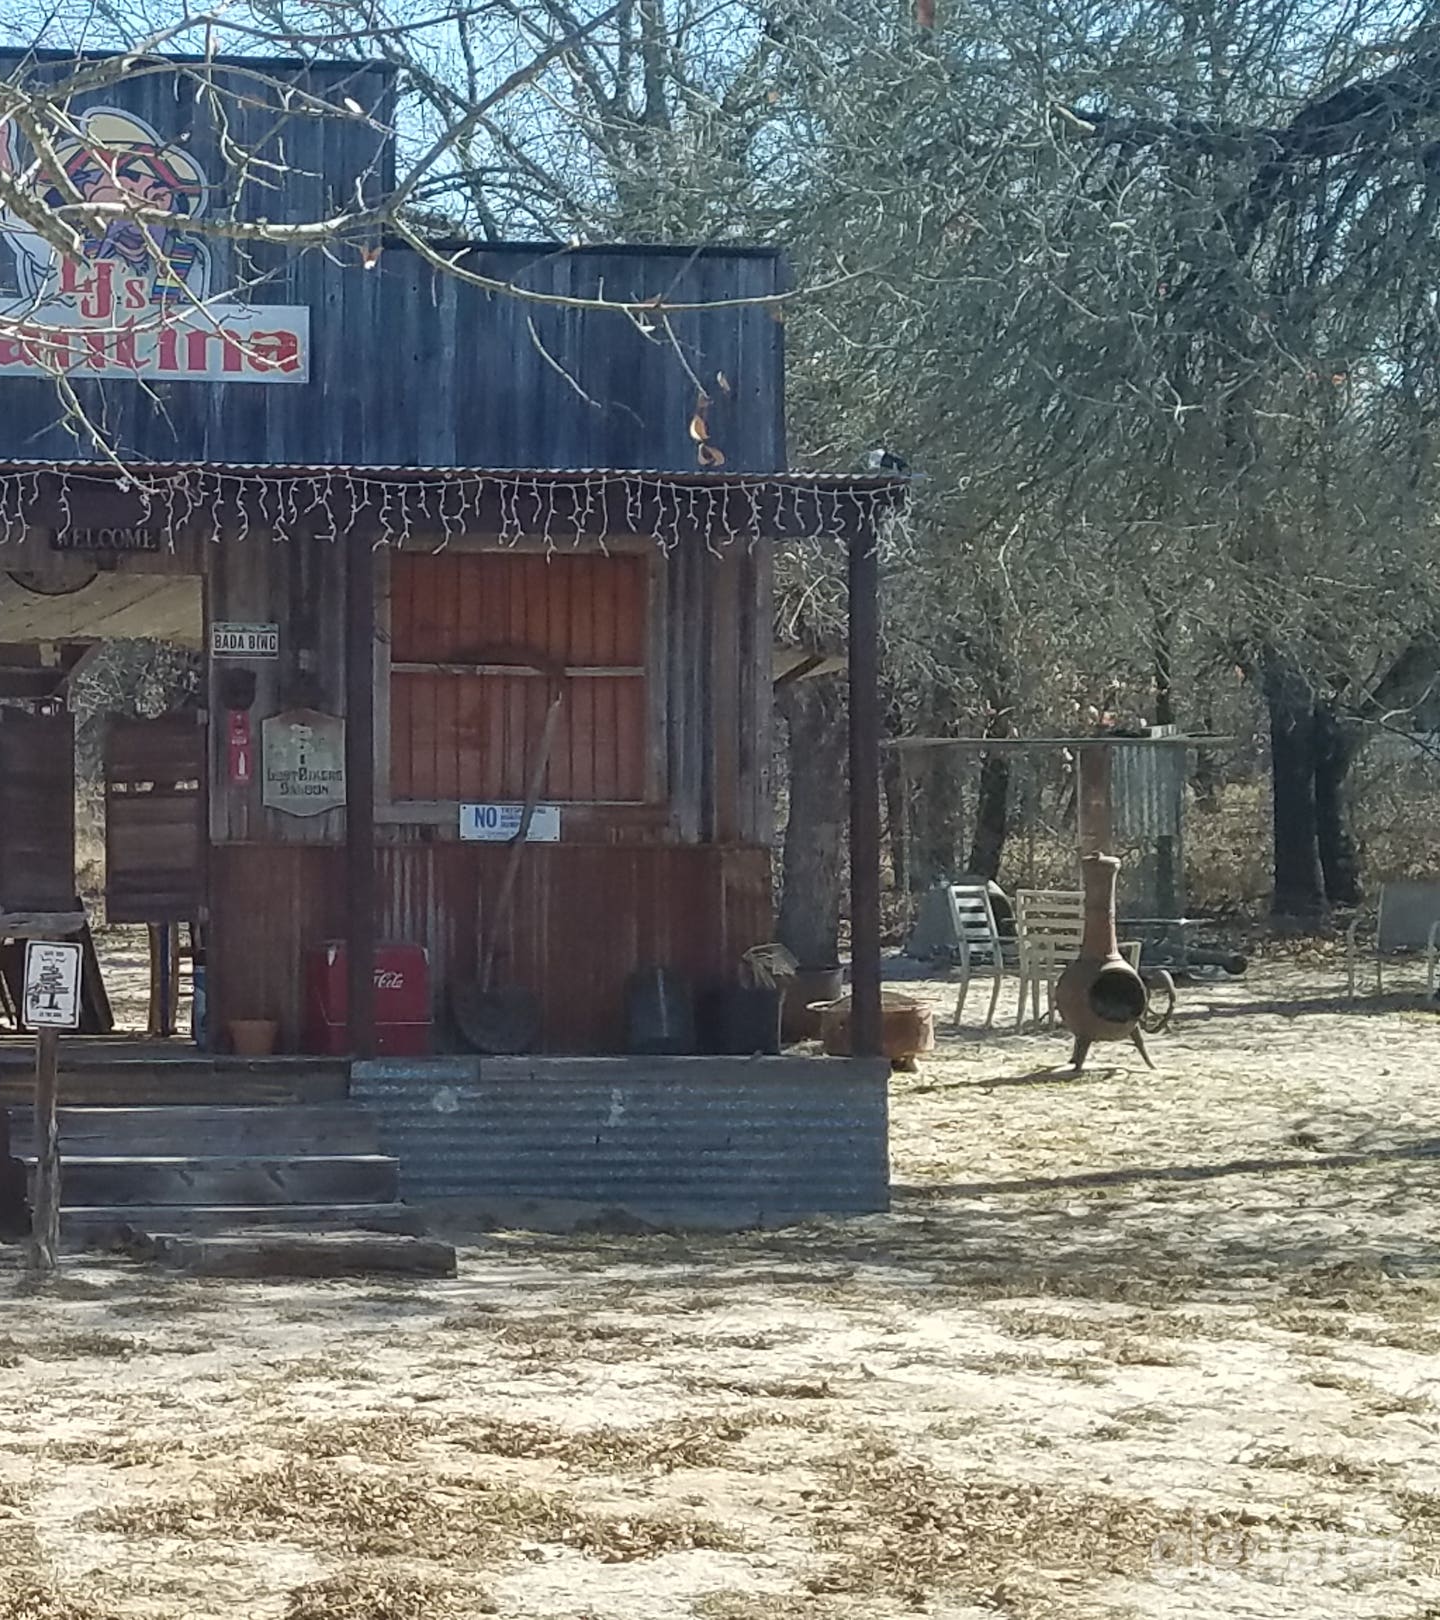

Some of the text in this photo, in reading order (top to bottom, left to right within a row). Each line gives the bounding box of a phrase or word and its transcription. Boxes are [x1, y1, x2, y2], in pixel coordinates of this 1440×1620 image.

[55, 527, 156, 549] WELCOME
[214, 634, 244, 649] BADA
[474, 806, 497, 829] NO
